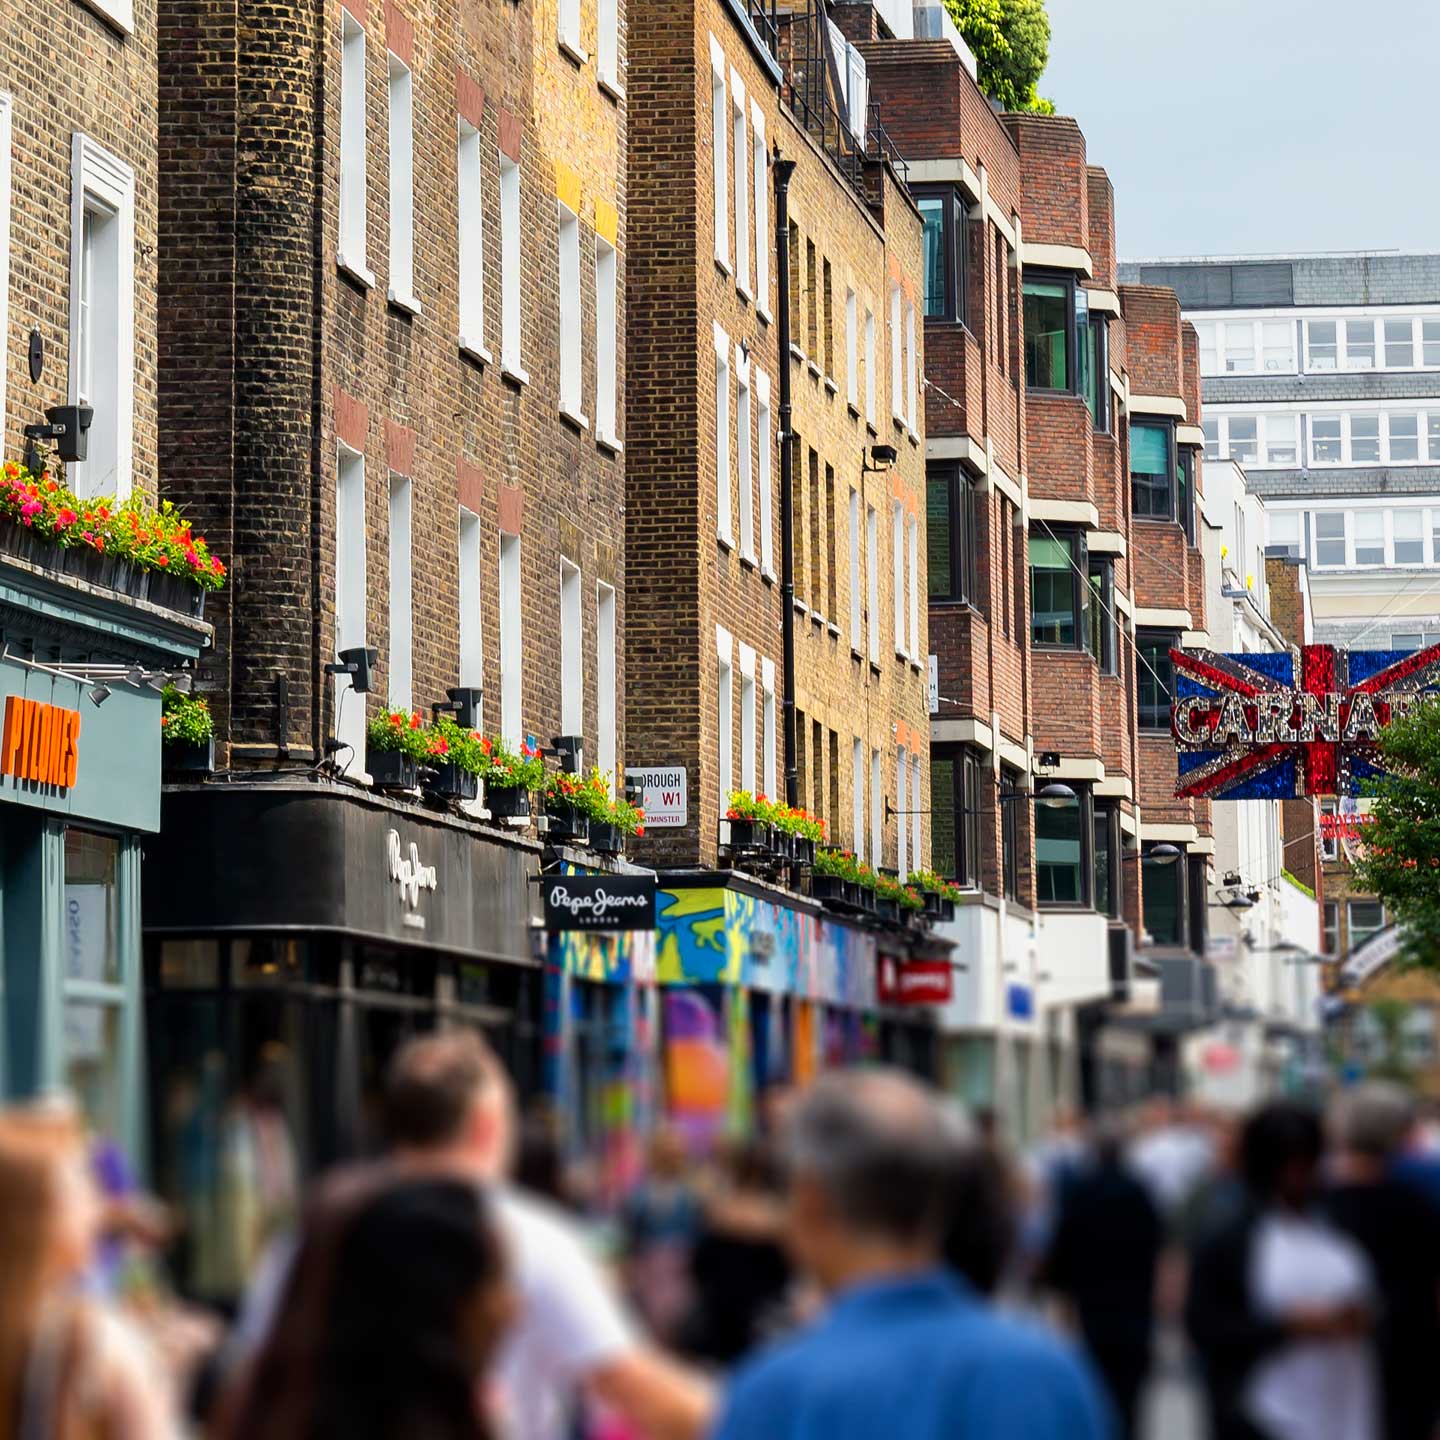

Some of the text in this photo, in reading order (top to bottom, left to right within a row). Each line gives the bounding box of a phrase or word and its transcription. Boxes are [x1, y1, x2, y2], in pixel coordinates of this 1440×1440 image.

[1174, 691, 1439, 743] CARNA
[1, 695, 81, 789] PYLONES
[662, 792, 680, 805] W1
[550, 885, 648, 915] Pepe Jeans
